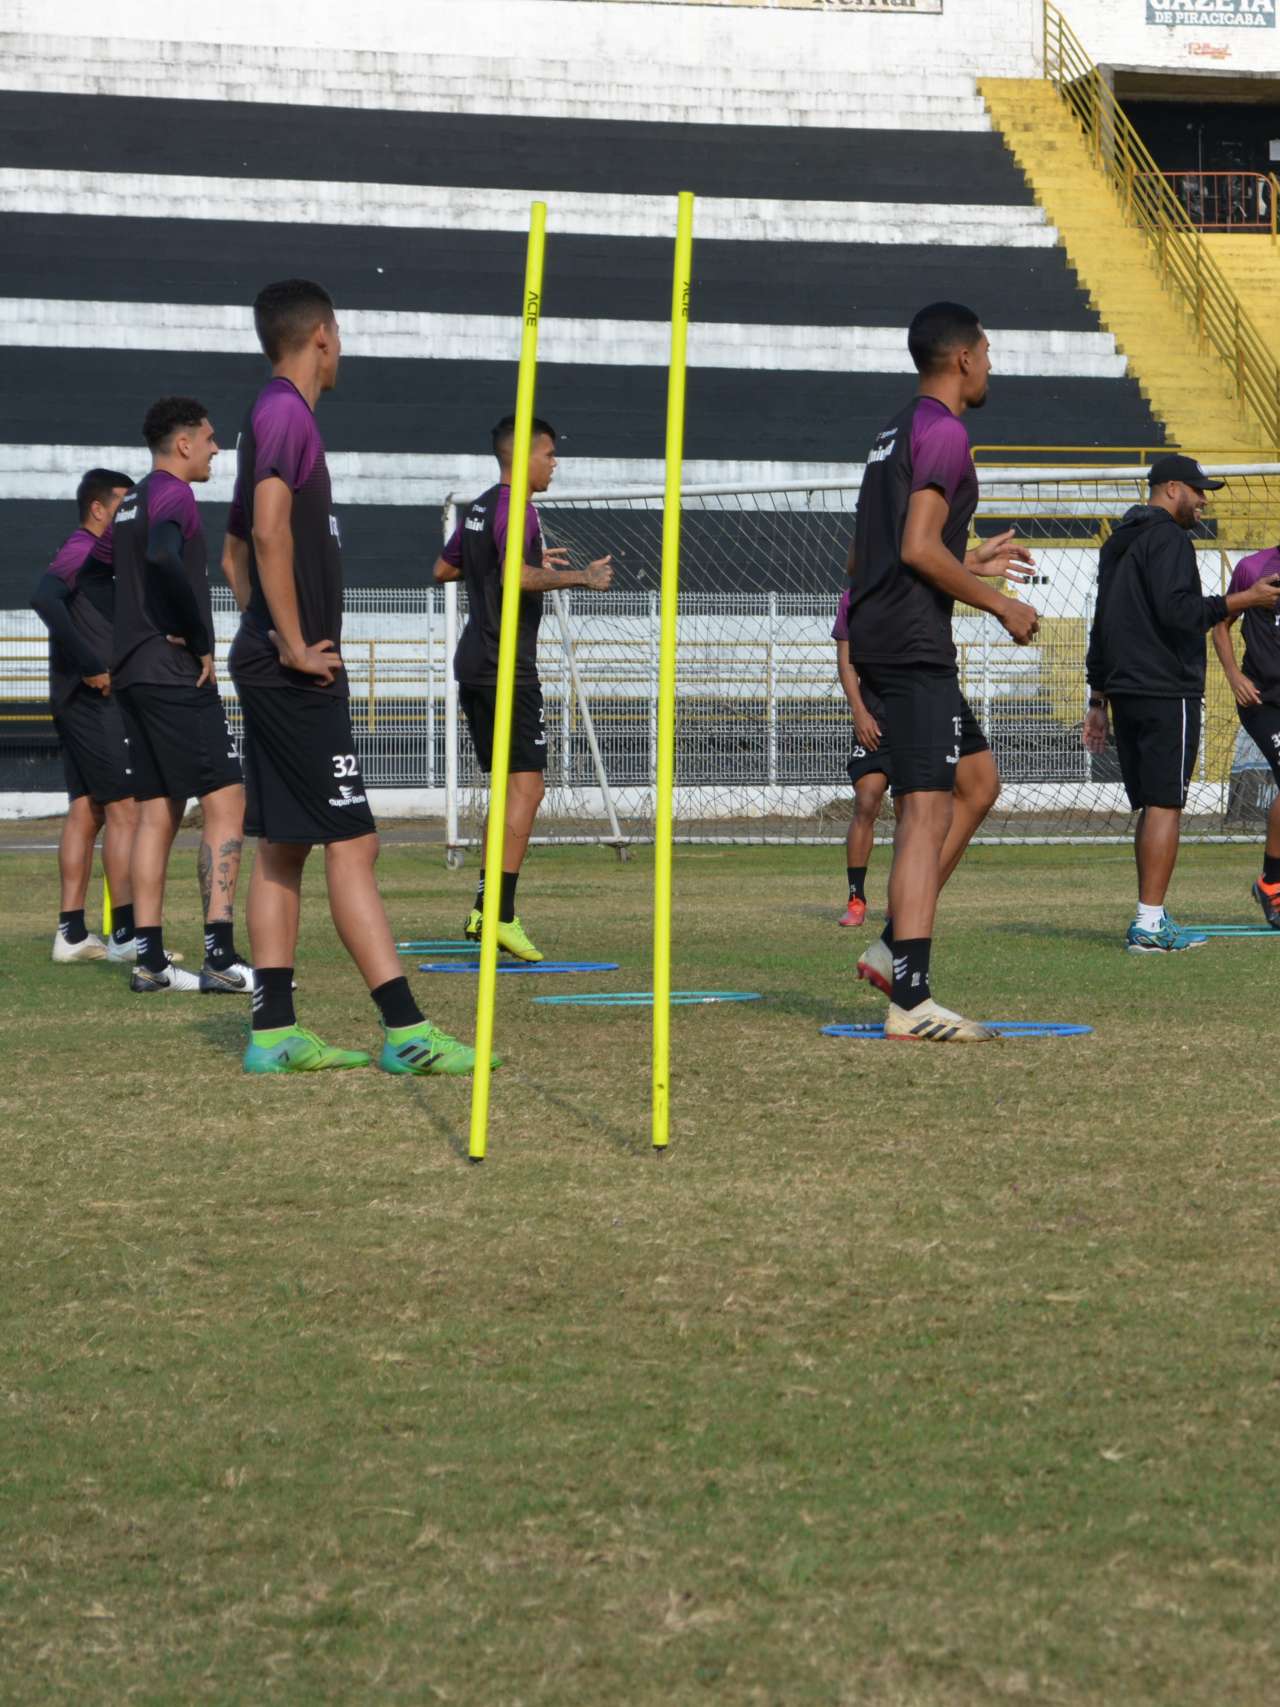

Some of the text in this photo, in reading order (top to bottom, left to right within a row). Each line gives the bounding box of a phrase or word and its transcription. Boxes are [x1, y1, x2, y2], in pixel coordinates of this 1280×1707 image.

[1154, 11, 1268, 26] DE PIRACICABA
[852, 745, 866, 757] 25
[332, 754, 359, 778] 32
